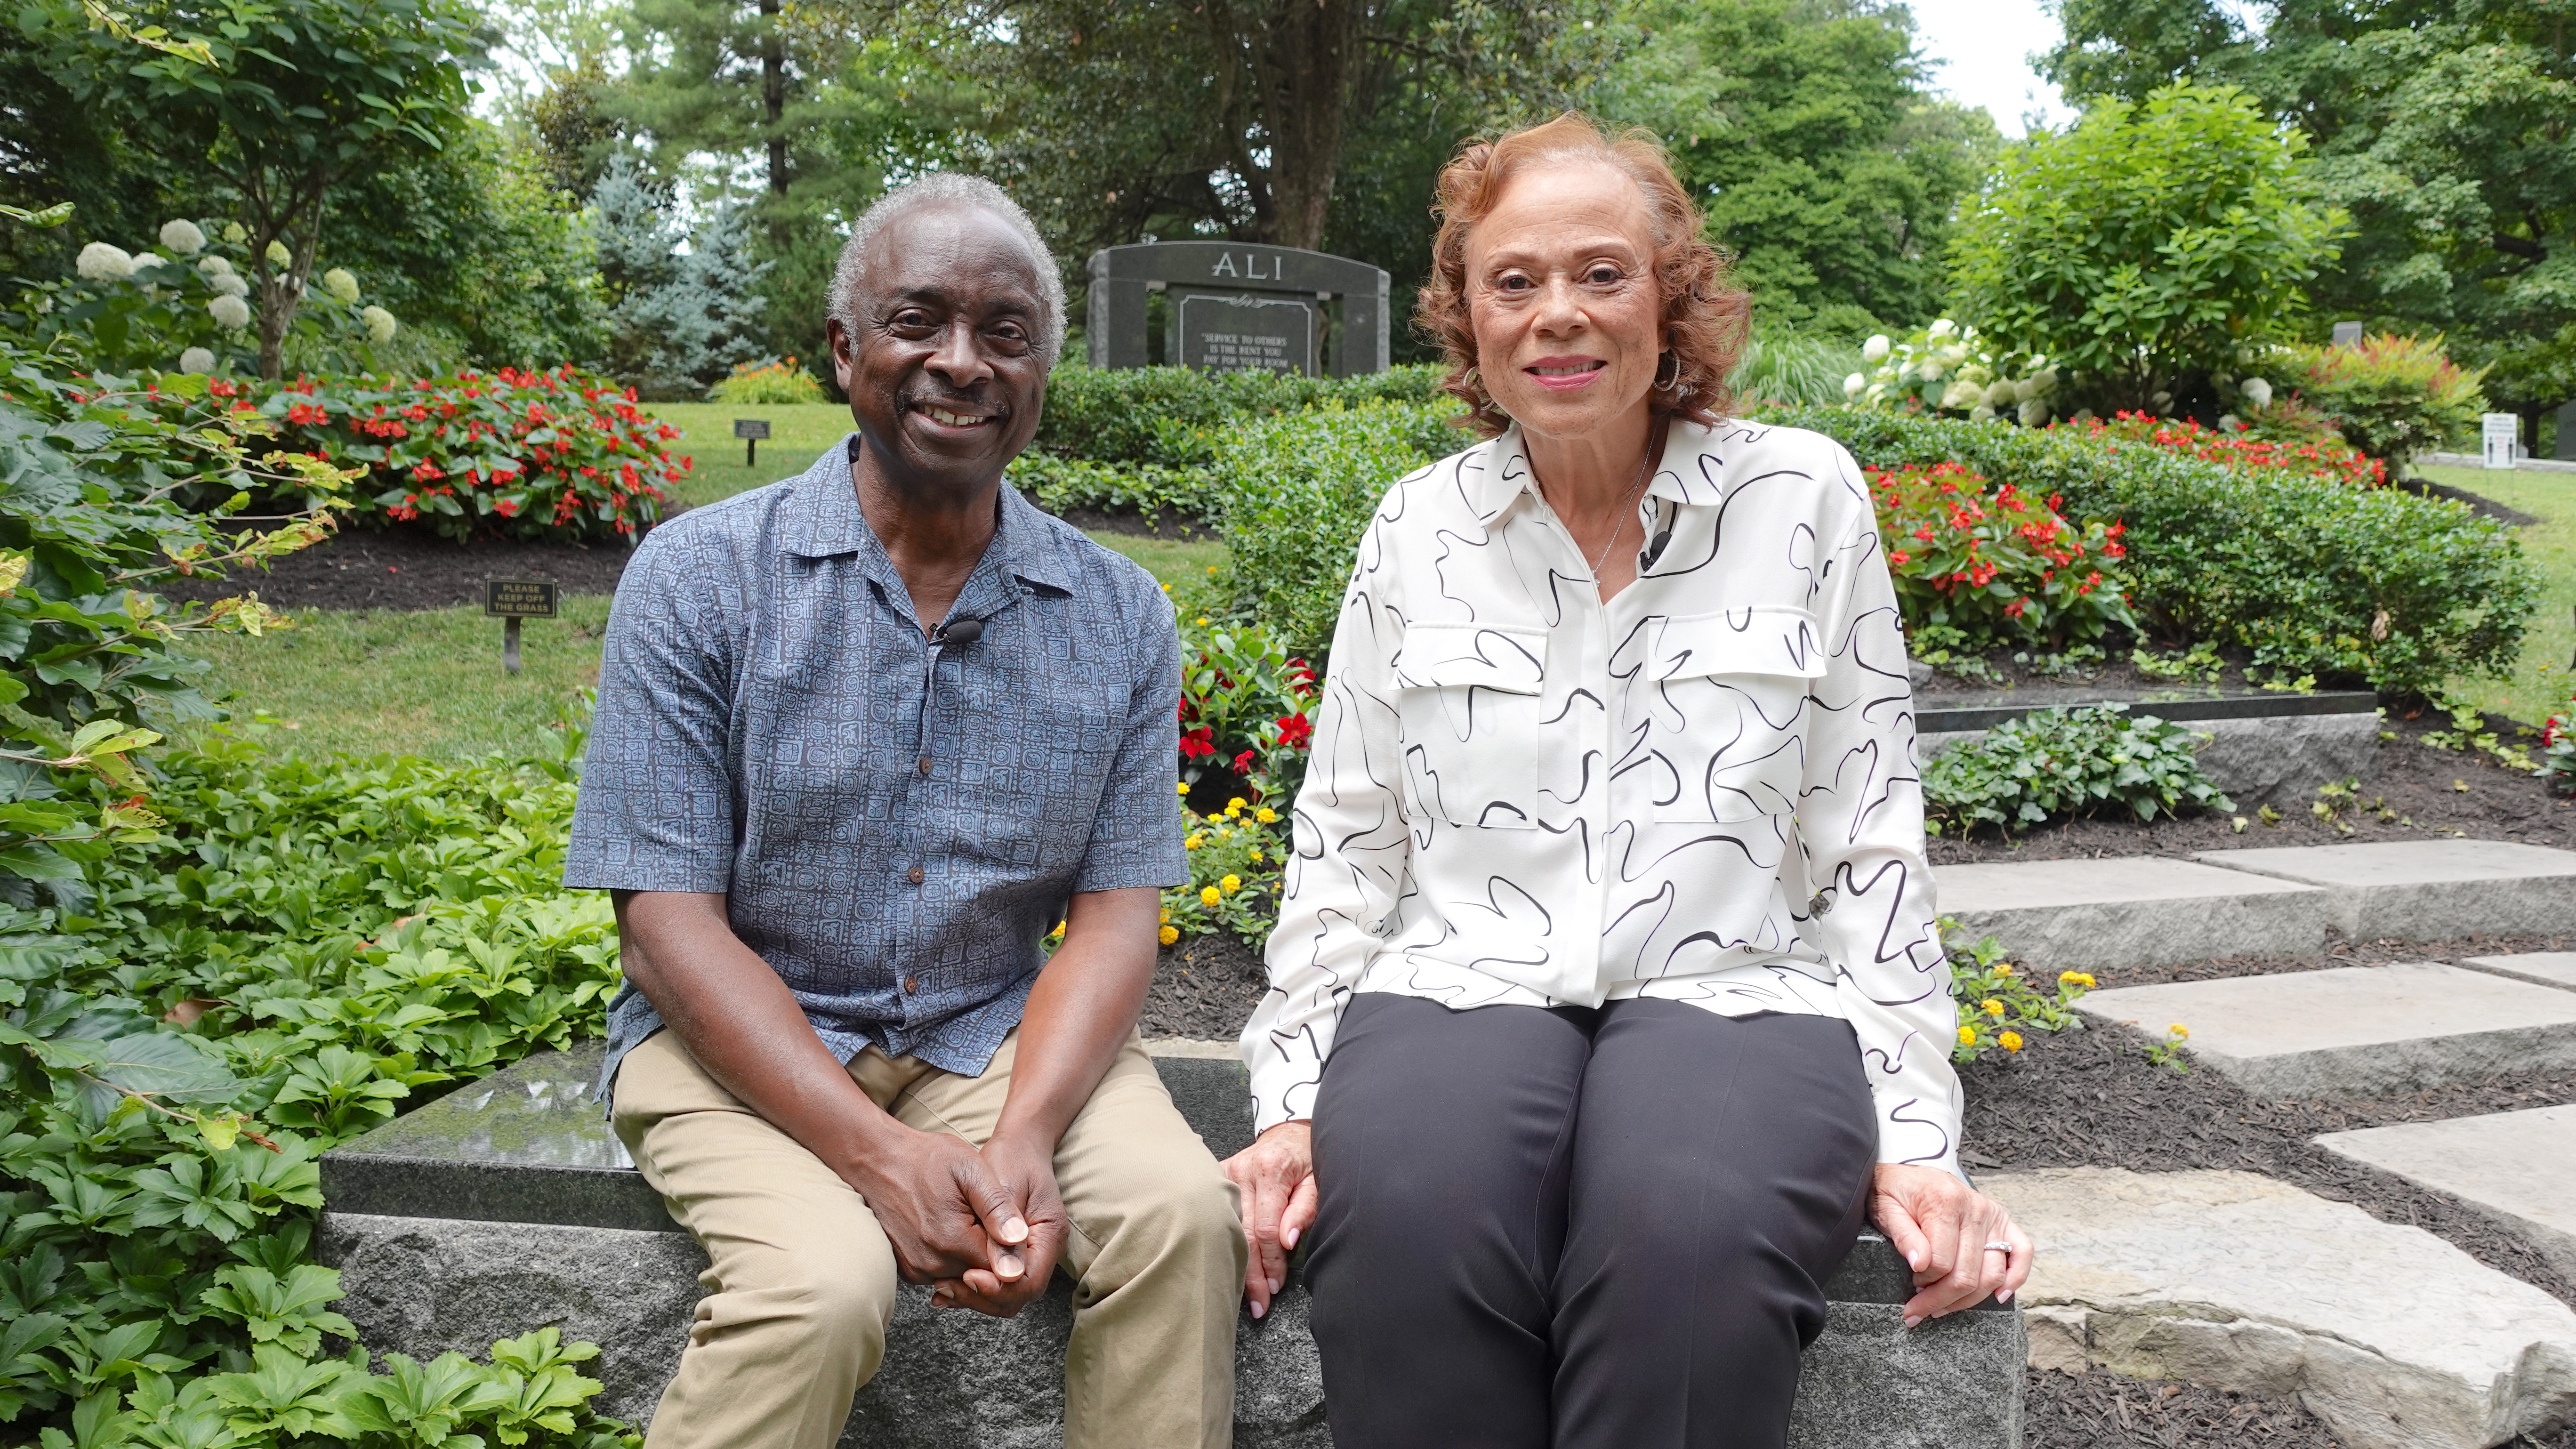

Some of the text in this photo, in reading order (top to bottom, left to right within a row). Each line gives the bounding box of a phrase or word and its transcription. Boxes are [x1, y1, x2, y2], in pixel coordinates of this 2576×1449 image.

[1212, 251, 1282, 281] ALI
[1241, 335, 1253, 345] TO
[1254, 336, 1287, 347] OTHERS
[1209, 344, 1282, 357] IS THE RENT YOU
[1203, 354, 1288, 368] PAY FOR YOUR ROOM
[503, 583, 540, 594] PLEASE
[498, 593, 546, 603] KEEP OFF
[495, 602, 548, 612] THE GRASS
